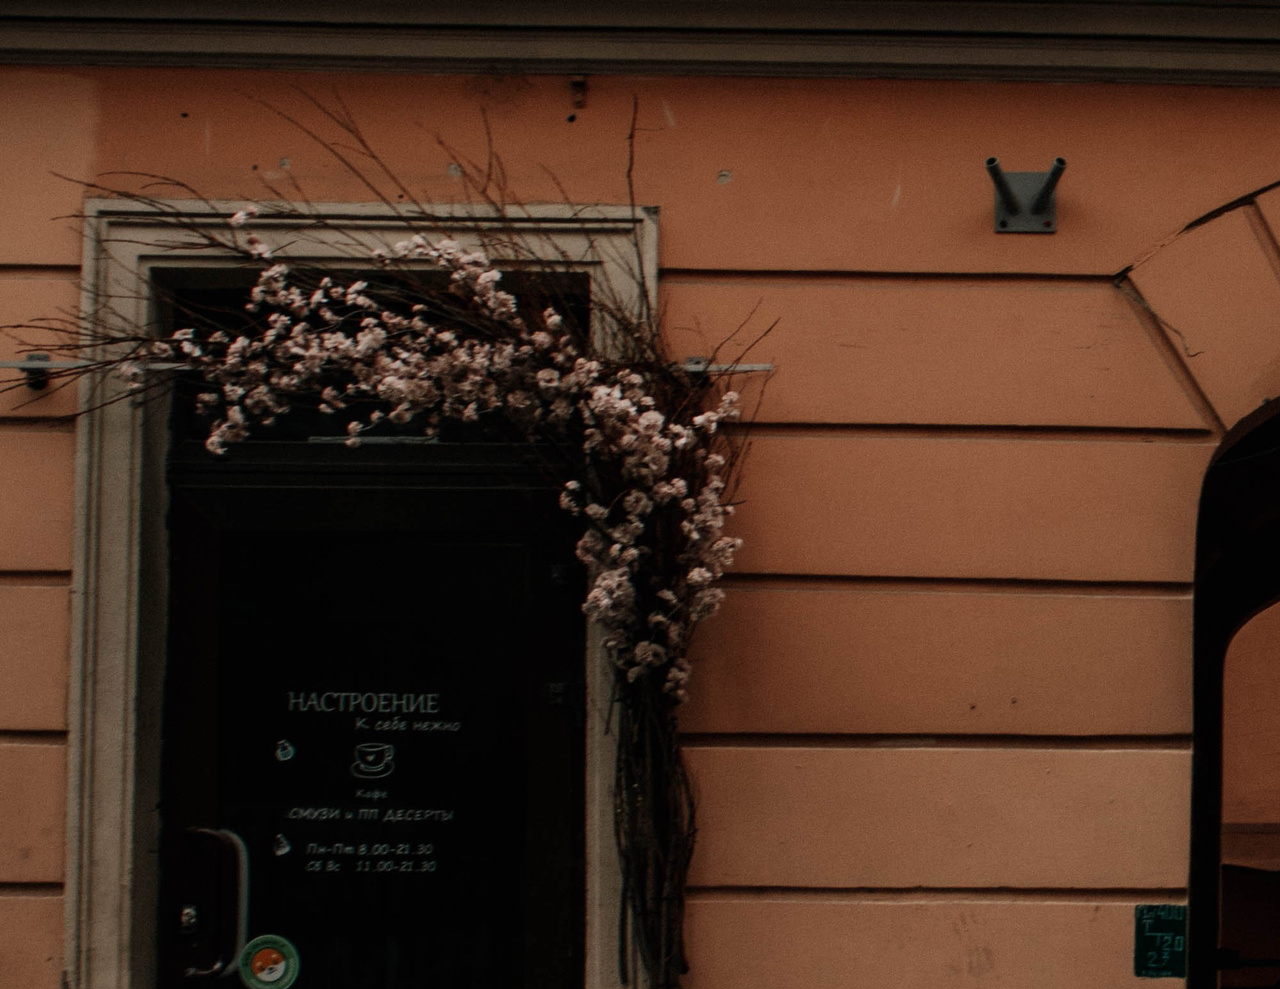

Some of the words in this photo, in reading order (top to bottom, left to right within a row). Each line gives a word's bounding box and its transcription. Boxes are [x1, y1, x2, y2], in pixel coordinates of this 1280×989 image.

[287, 691, 440, 714] НАСТРОЕНИЕ
[374, 715, 408, 731] себе
[412, 721, 462, 732] нежно
[382, 809, 454, 823] ДЕСЕРТЫ
